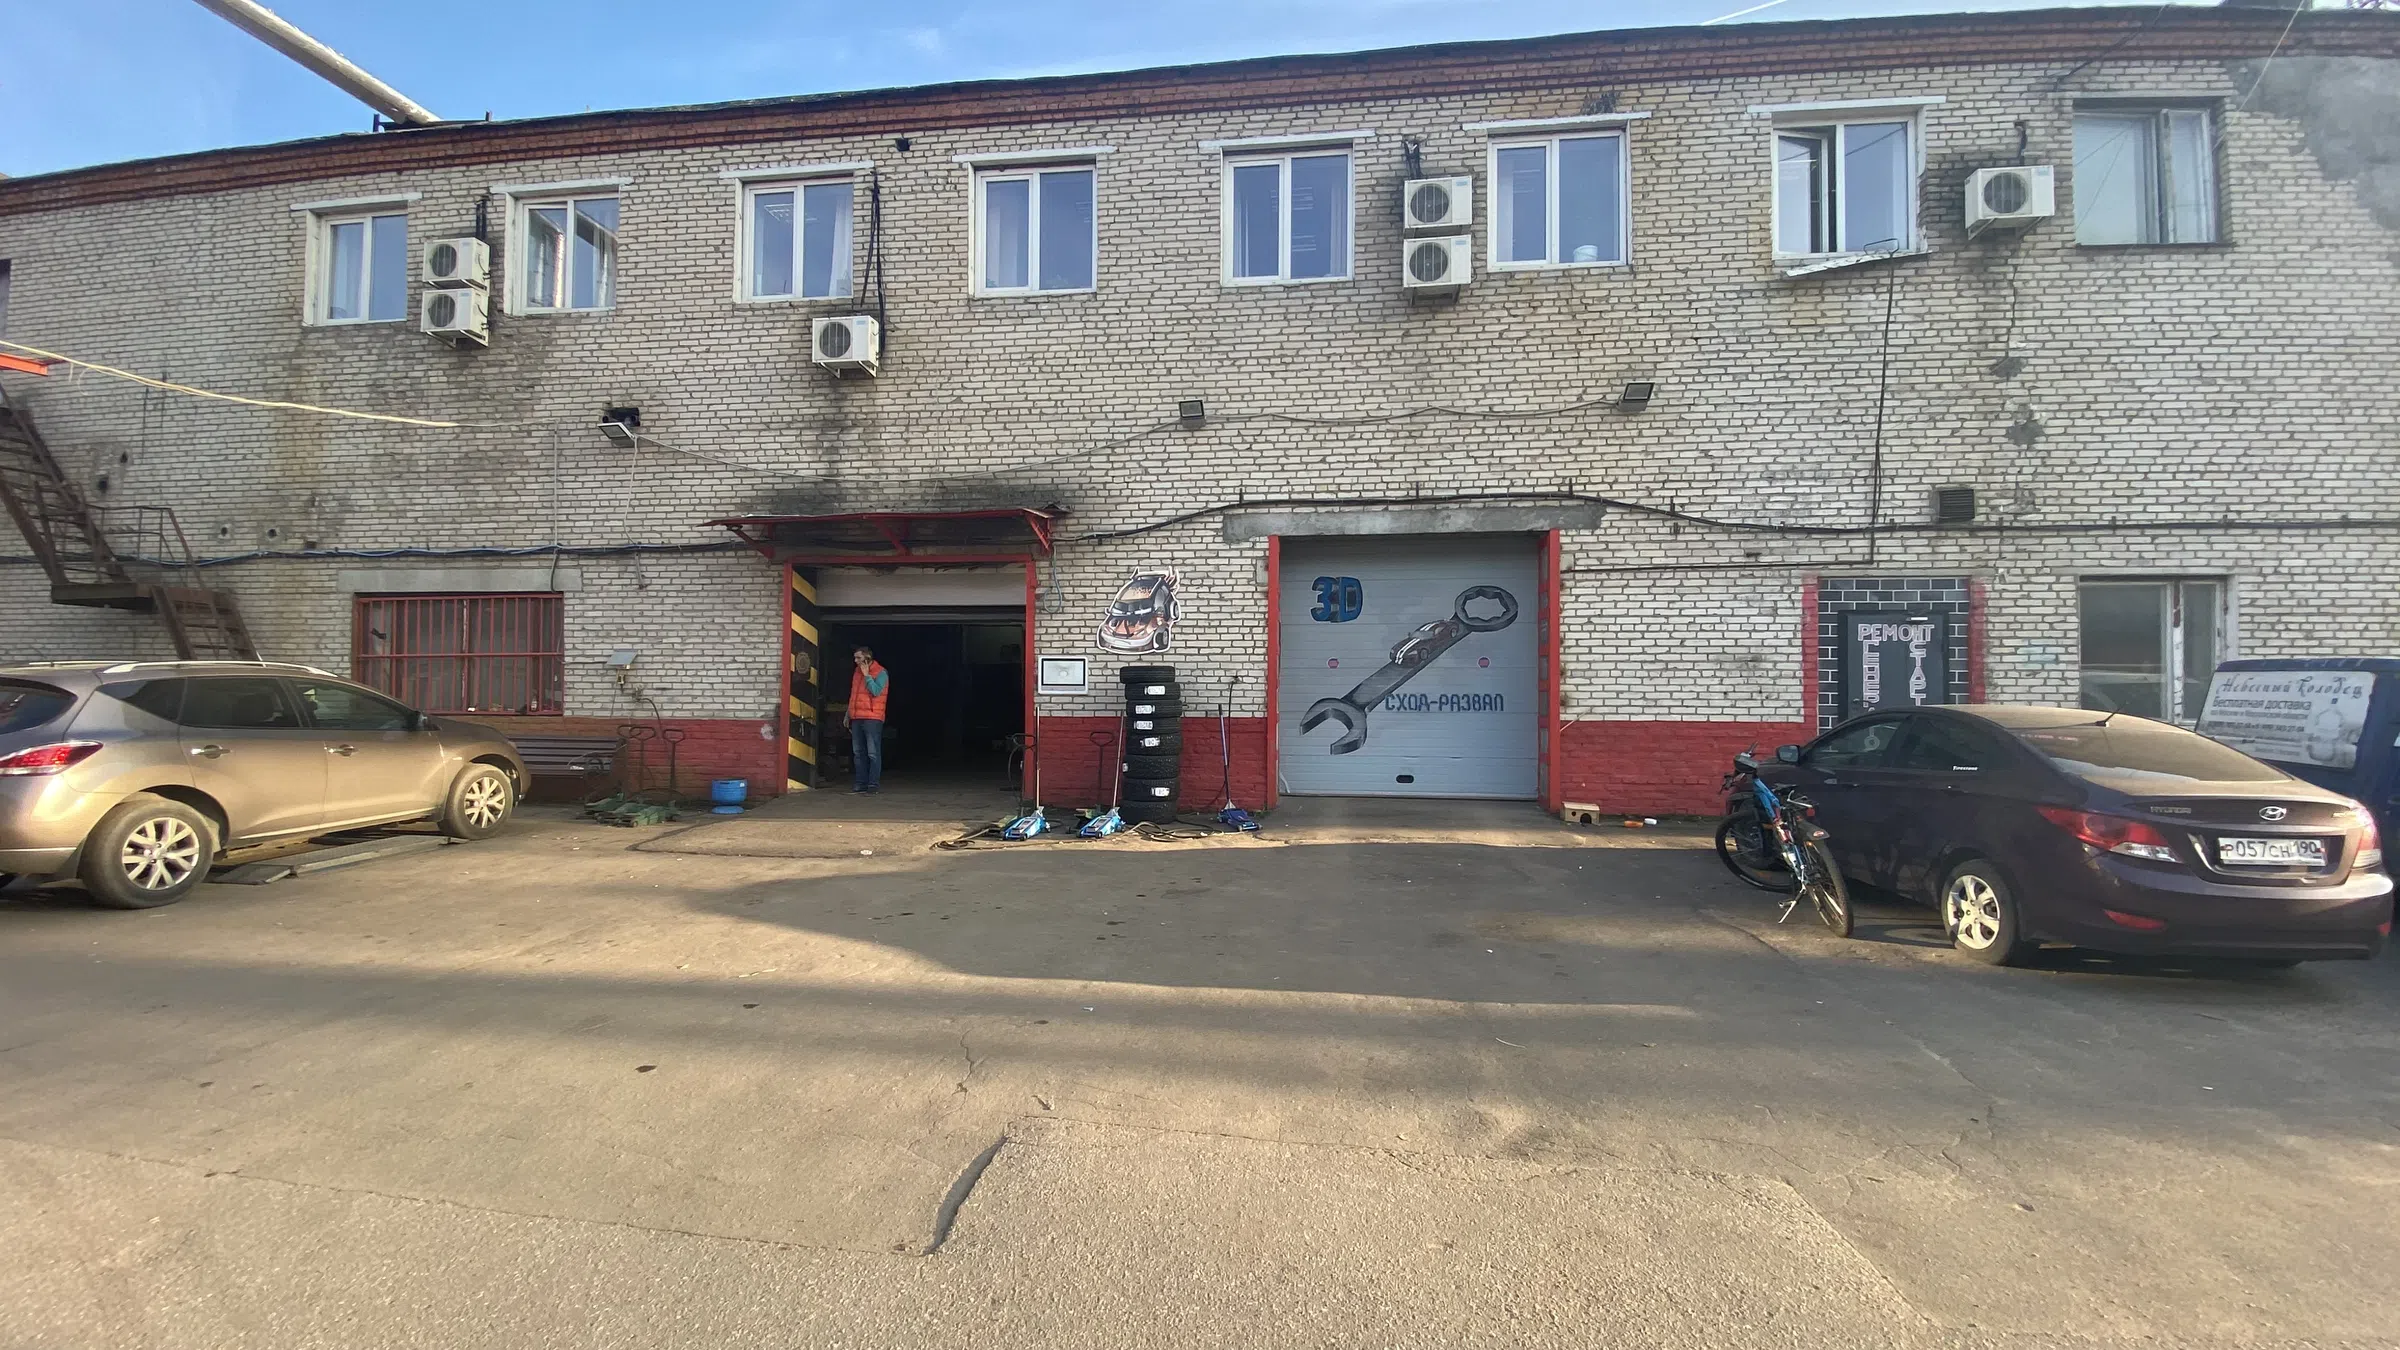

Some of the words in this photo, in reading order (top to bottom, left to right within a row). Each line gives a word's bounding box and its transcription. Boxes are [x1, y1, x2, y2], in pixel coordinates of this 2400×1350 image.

[1311, 576, 1364, 623] 3D
[1857, 623, 1935, 642] РЕМОНТ
[2292, 839, 2318, 854] 190
